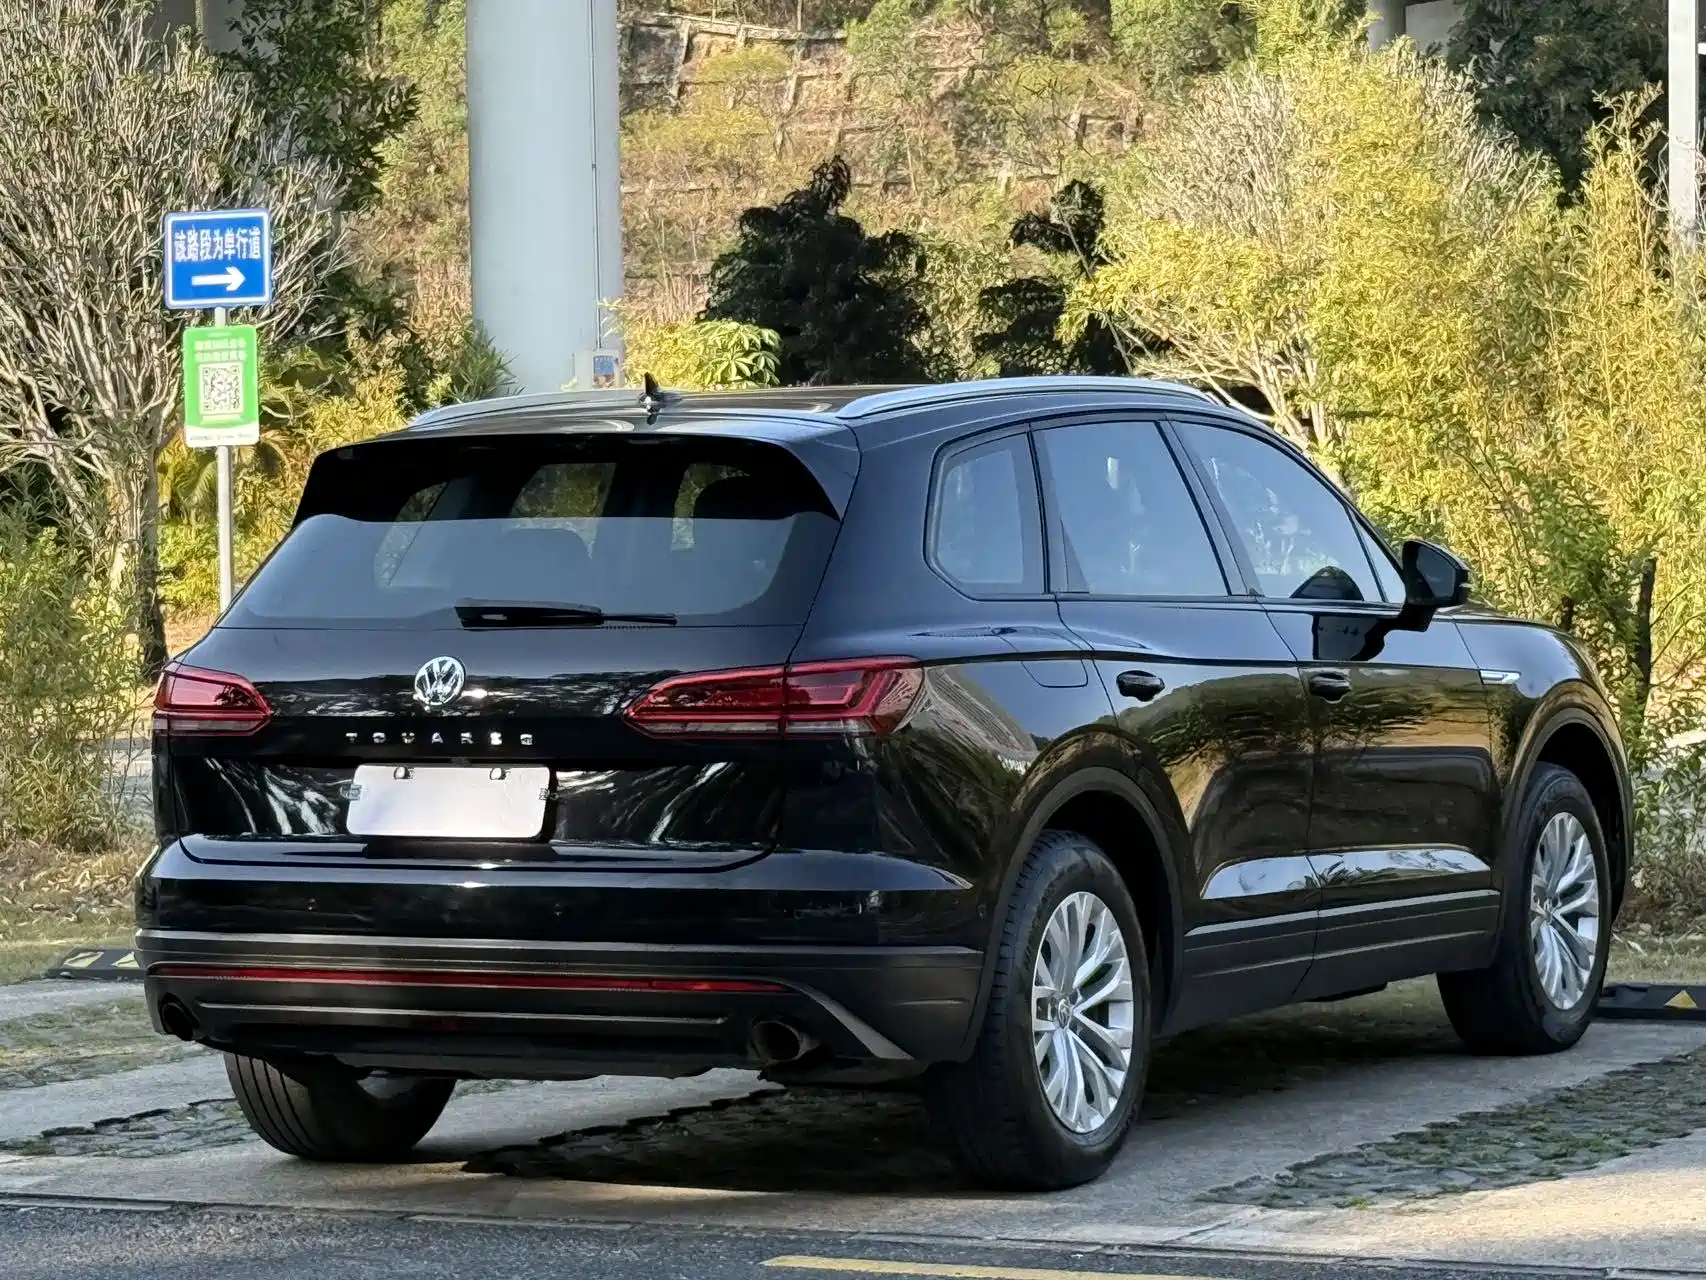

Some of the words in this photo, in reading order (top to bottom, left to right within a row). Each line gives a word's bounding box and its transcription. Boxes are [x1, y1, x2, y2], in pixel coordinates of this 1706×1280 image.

[174, 226, 261, 262] 该路段为单行道
[345, 731, 533, 746] TOUAREG
